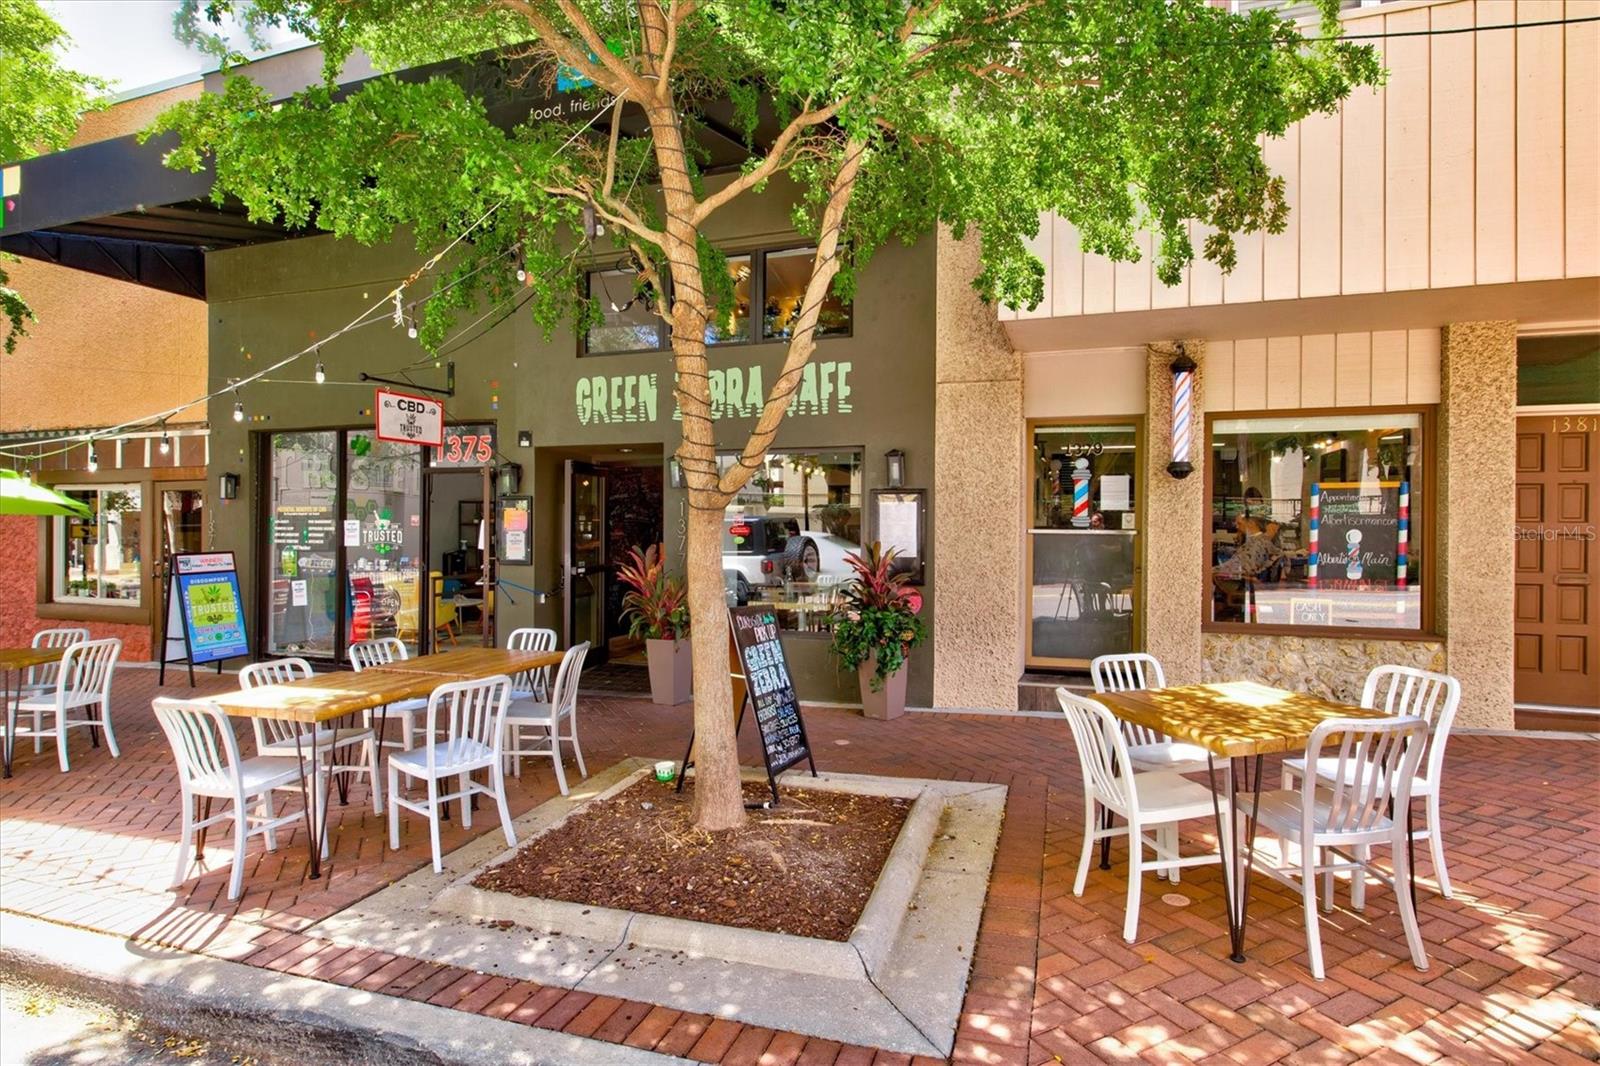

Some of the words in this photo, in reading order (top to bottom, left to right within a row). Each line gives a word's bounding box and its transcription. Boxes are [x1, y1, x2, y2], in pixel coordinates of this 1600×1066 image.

[576, 373, 657, 425] GREEN
[672, 365, 764, 420] BRA
[397, 399, 425, 414] CBD
[1552, 416, 1599, 433] 1381
[436, 435, 493, 463] 1375
[1065, 443, 1104, 457] 1379
[363, 529, 403, 544] TRUSTED
[1362, 552, 1391, 567] Main
[190, 601, 236, 617] TRUSTED
[766, 623, 777, 640] UP
[744, 639, 784, 672] GREEN
[750, 663, 791, 697] ZEBRA
